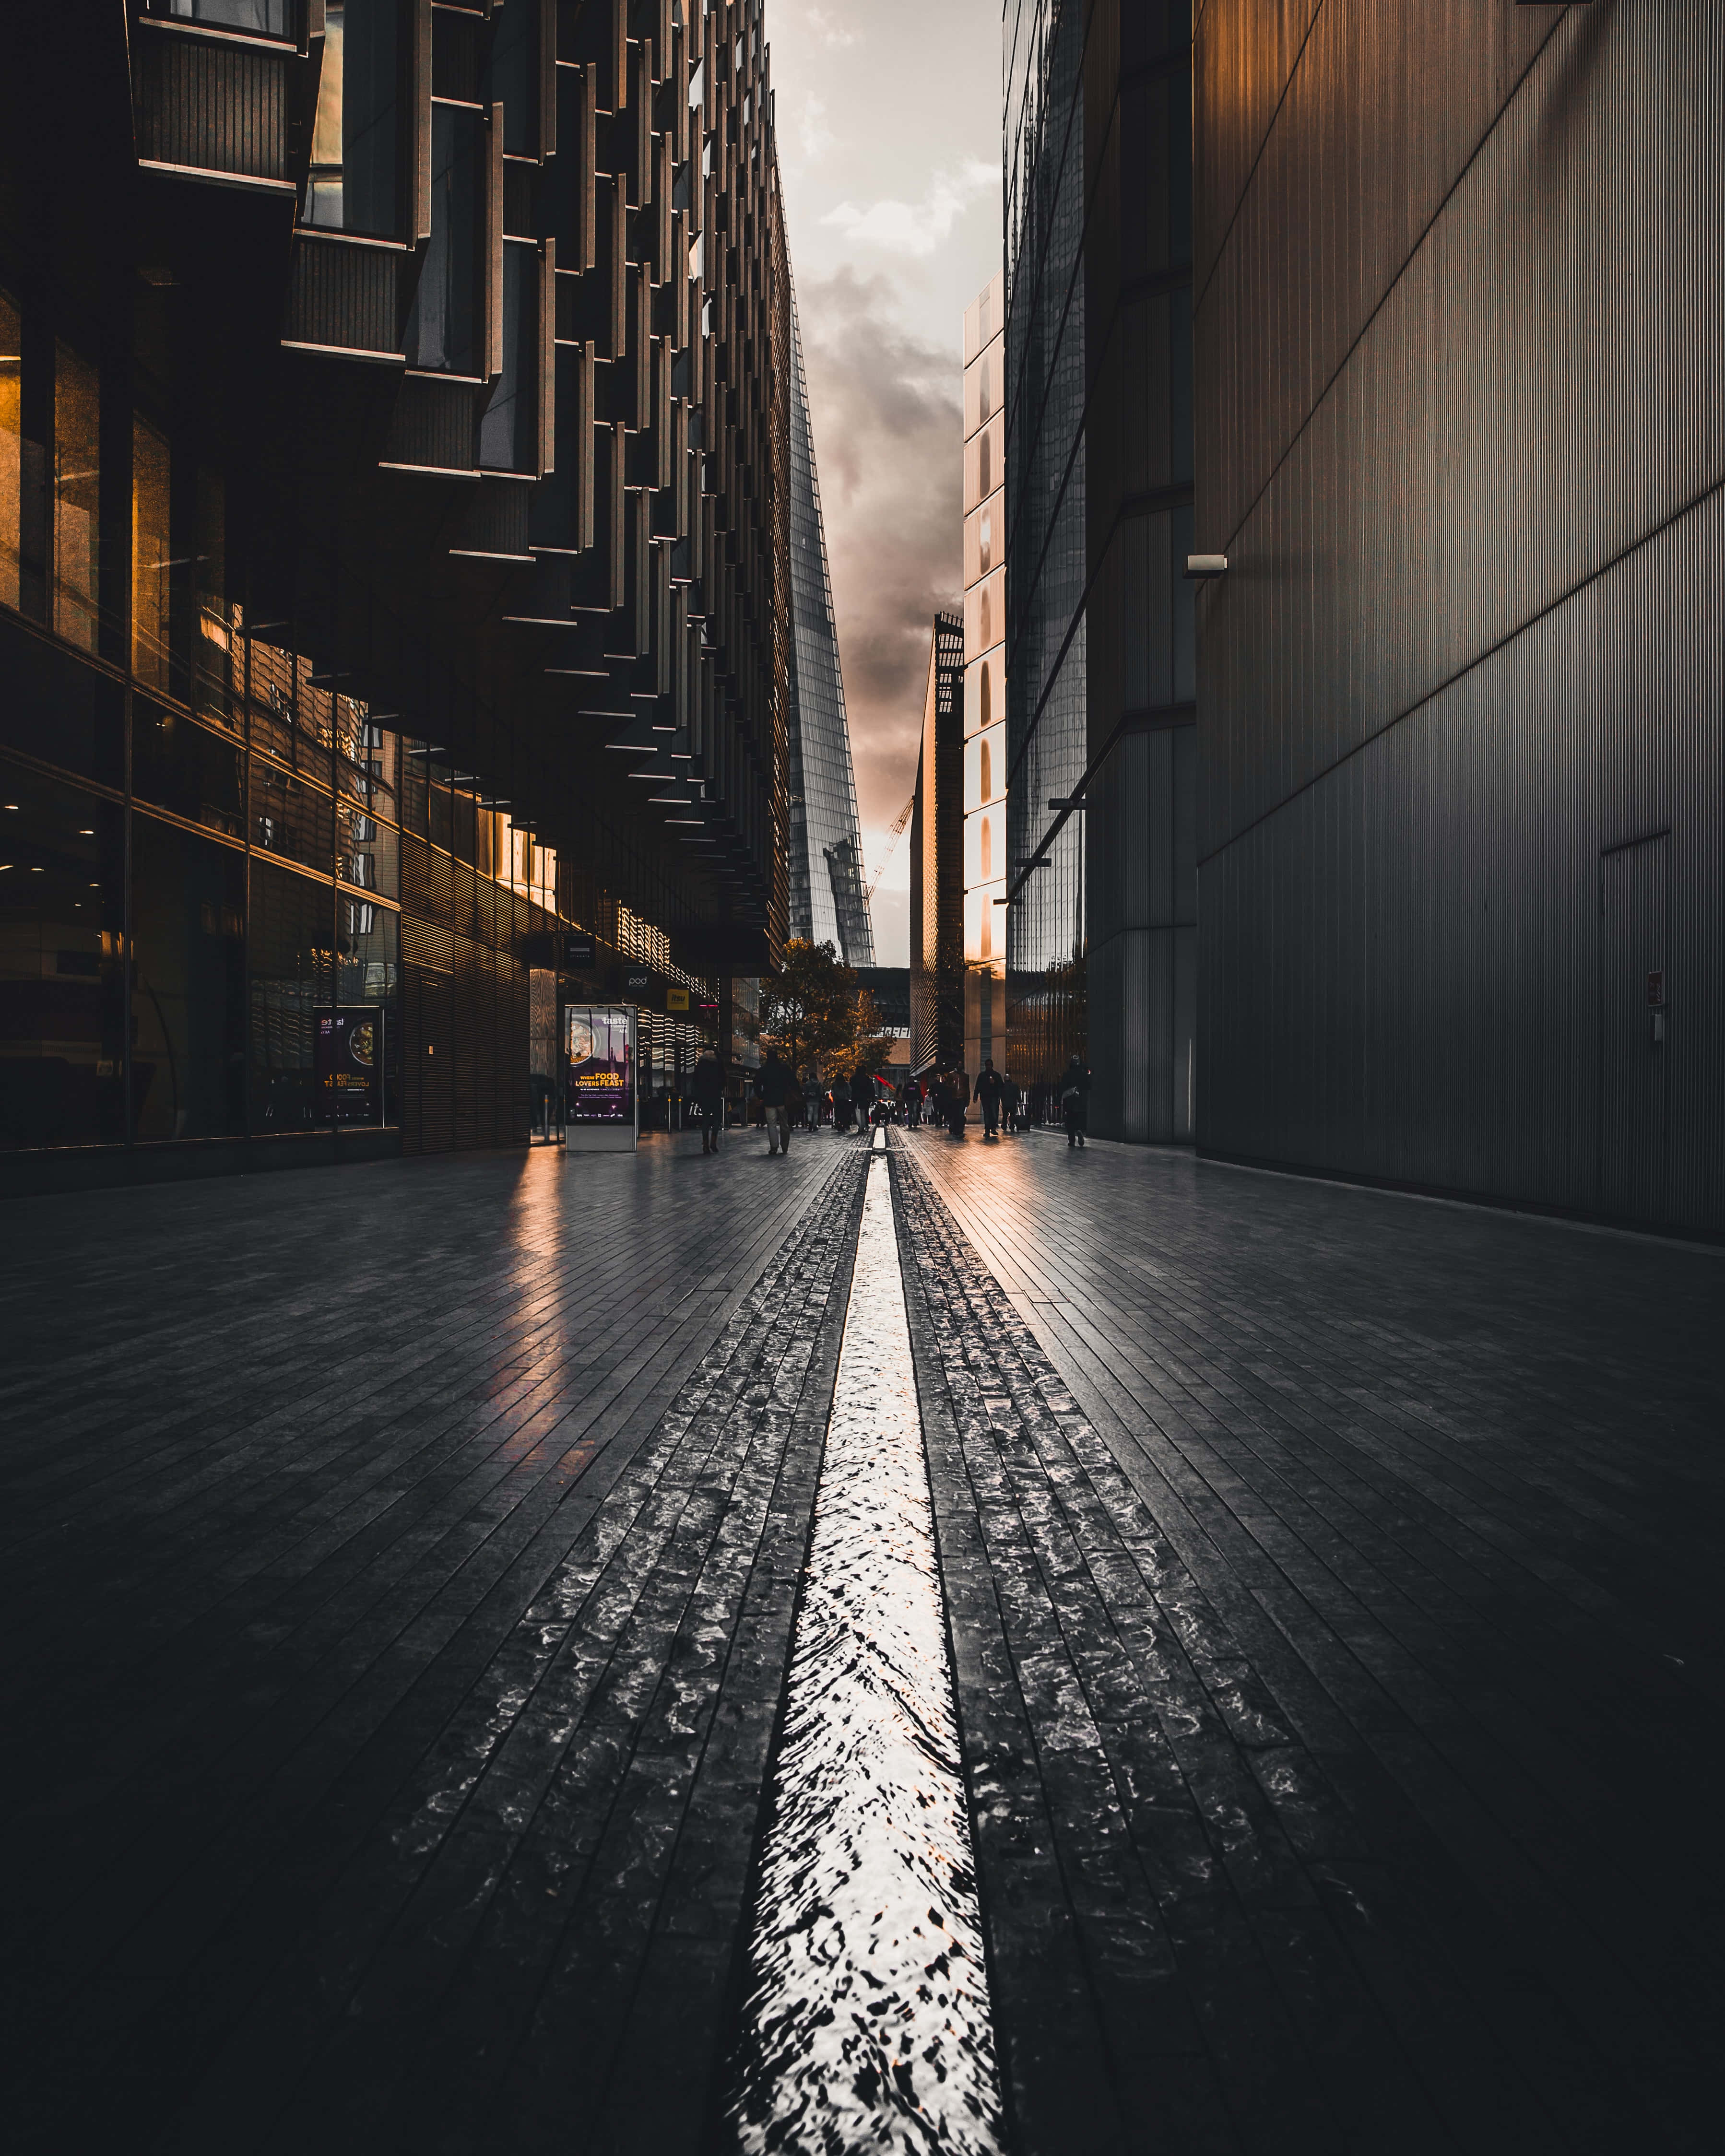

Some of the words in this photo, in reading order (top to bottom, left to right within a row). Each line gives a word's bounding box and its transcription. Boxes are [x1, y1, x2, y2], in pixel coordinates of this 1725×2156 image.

[629, 976, 647, 986] pod
[672, 994, 685, 1002] itsu
[602, 1016, 627, 1025] taste
